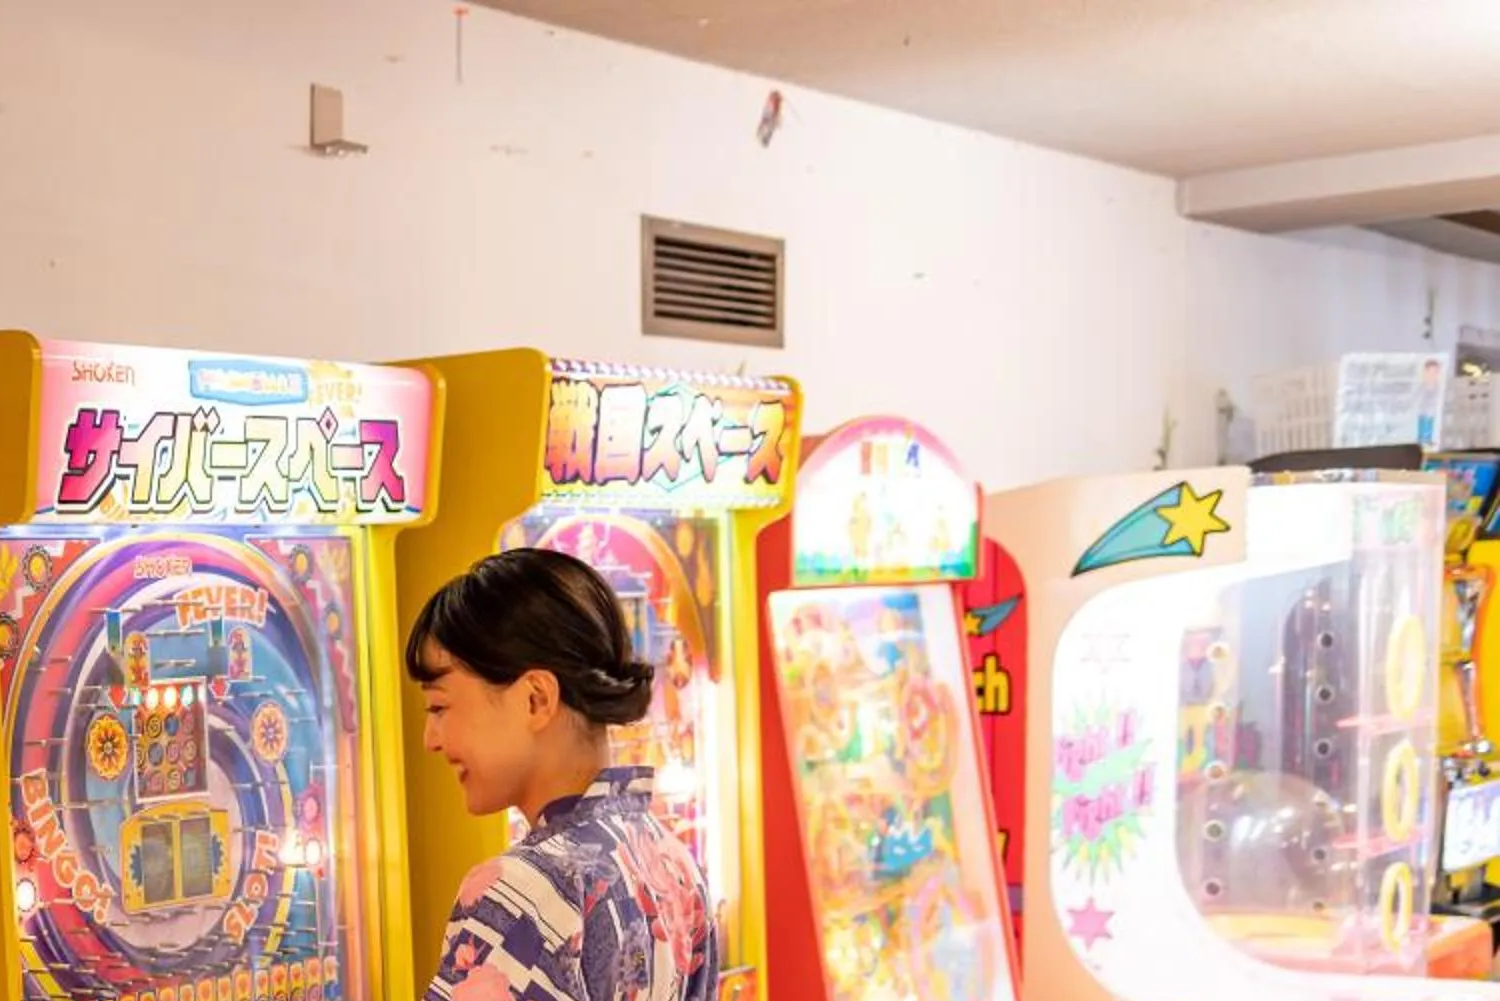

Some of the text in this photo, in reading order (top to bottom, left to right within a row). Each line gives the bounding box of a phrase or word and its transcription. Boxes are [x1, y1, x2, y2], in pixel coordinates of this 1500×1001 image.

[57, 405, 406, 508] サイバースペース
[173, 585, 269, 631] FEVER!
[20, 768, 113, 924] BINGO!
